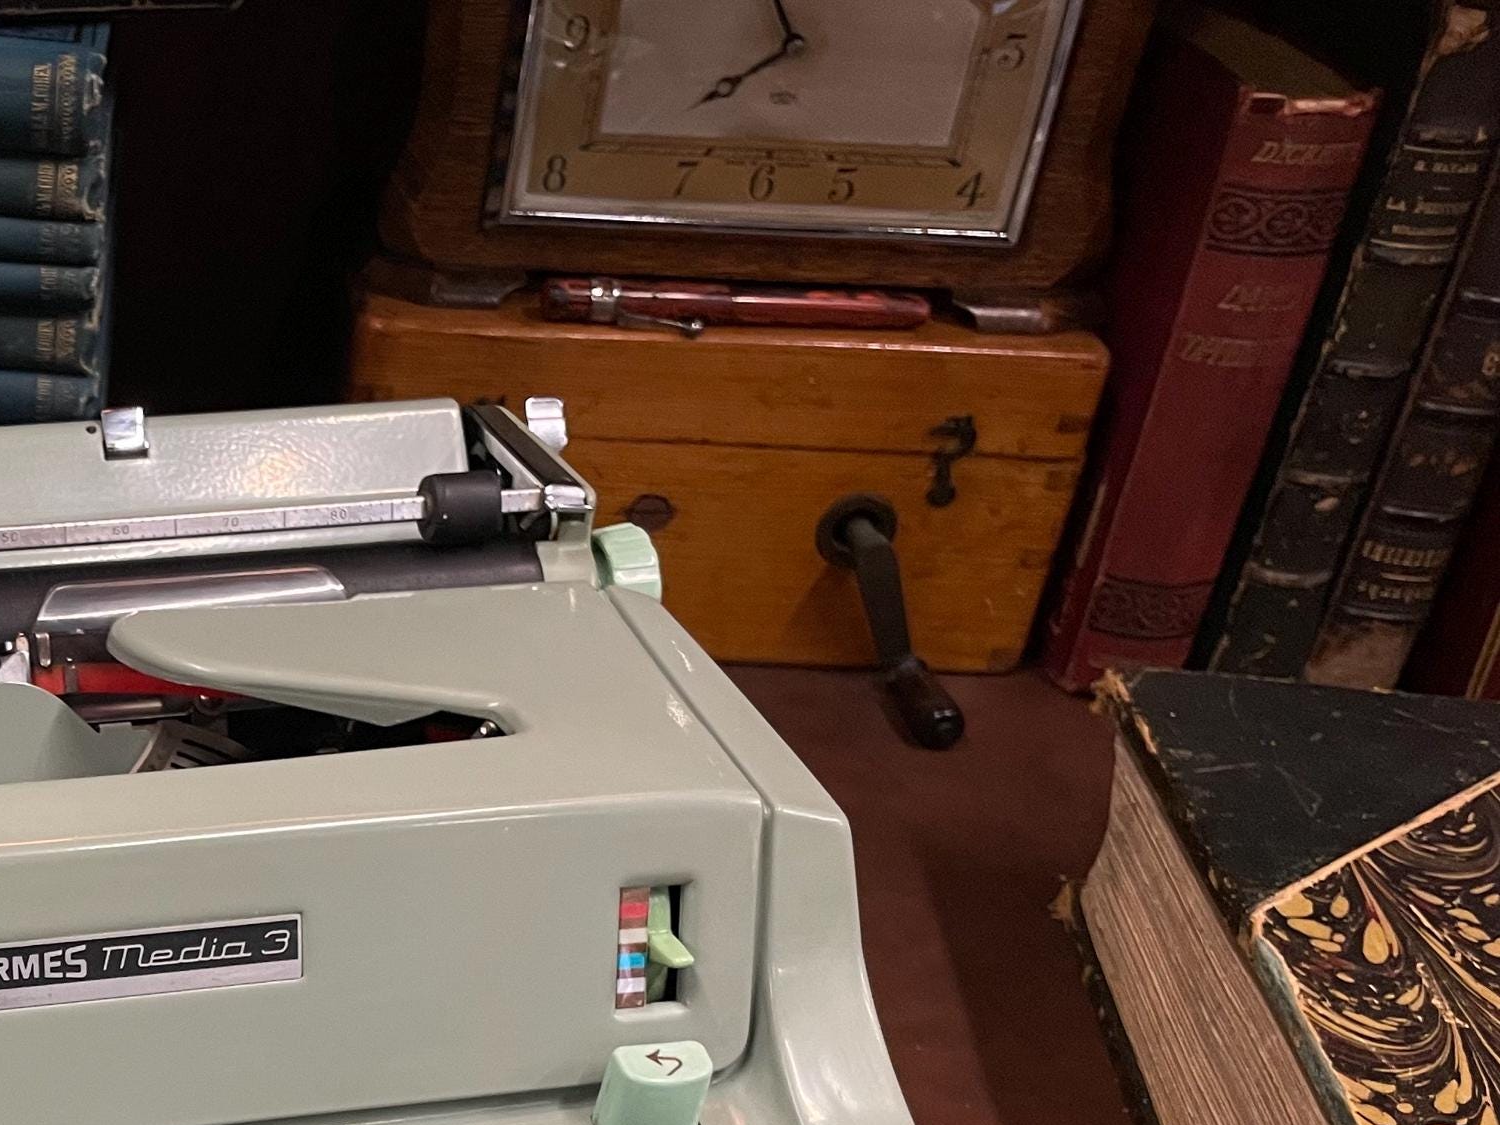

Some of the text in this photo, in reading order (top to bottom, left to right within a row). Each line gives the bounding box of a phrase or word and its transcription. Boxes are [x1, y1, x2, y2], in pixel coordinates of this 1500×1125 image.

[565, 14, 592, 53] 9
[999, 33, 1028, 71] 3
[541, 154, 986, 208] 8 7 6 5 4
[1, 531, 19, 544] 50
[111, 524, 130, 537] 60
[222, 516, 240, 529] 70
[329, 507, 348, 521] 80
[102, 937, 252, 972] Media
[261, 929, 292, 956] 3
